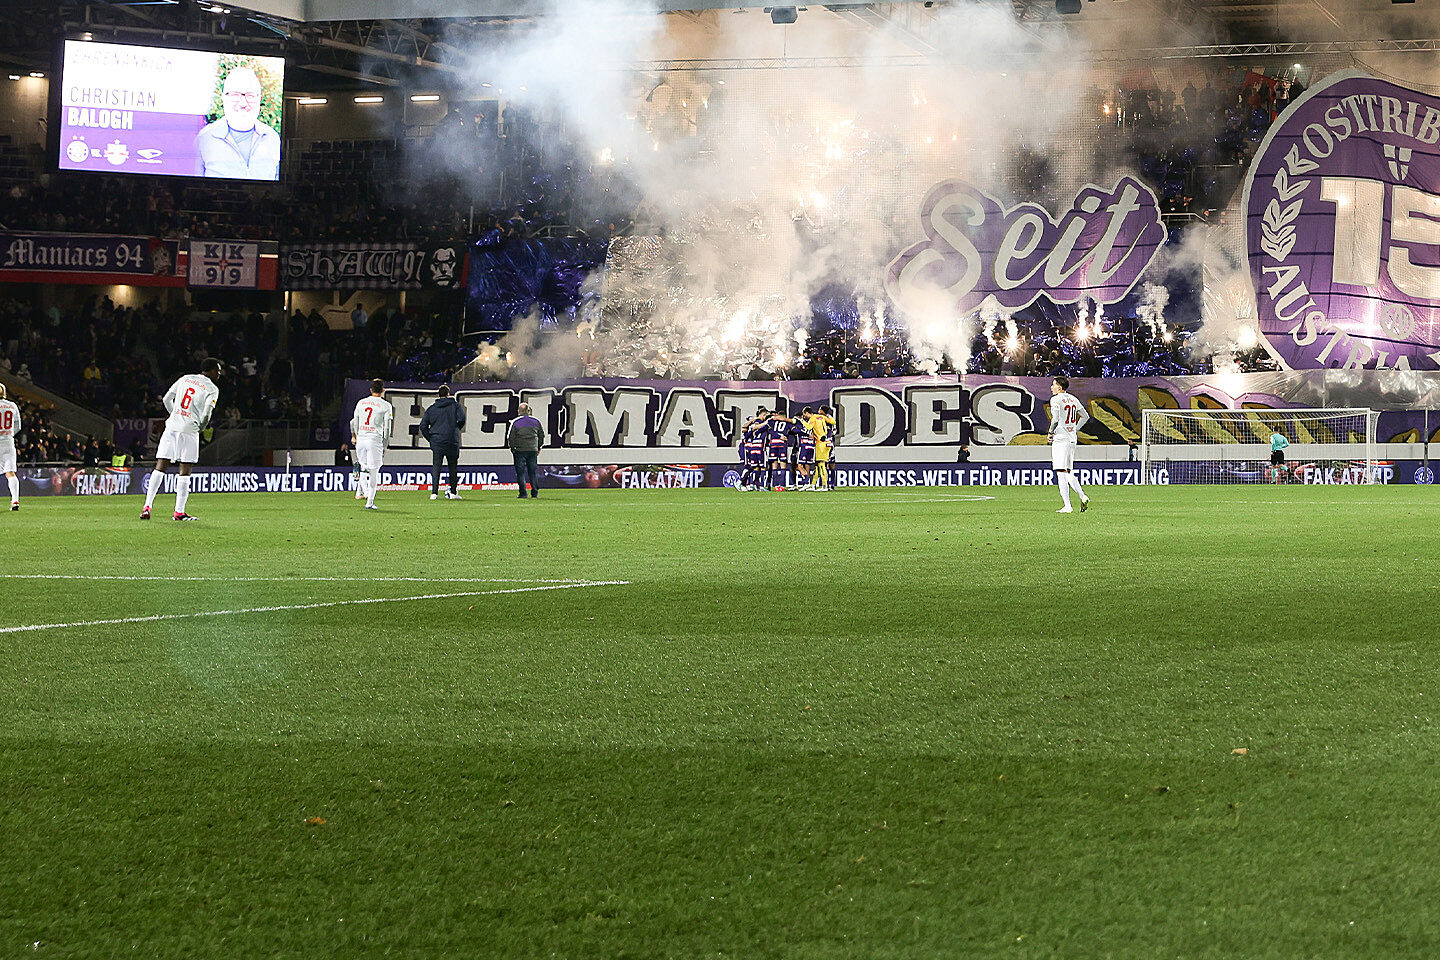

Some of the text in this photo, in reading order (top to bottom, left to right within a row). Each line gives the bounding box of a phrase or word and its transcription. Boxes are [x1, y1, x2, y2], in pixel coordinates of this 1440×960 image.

[70, 85, 157, 109] CHRISTIAN
[66, 107, 134, 130] BALOGH
[896, 181, 1150, 302] Seit
[3, 239, 144, 269] Maniacs 94
[403, 250, 426, 282] 97
[181, 387, 196, 410] 6
[364, 406, 374, 426] 7
[773, 420, 787, 432] 10
[832, 385, 1033, 447] DES
[210, 472, 310, 492] BUSINESS-WELT
[313, 468, 344, 492] FÜR
[837, 468, 966, 487] BUSINESS-WELT
[969, 465, 1001, 487] FÜR
[1006, 468, 1055, 486] MEHR
[1071, 468, 1170, 486] ERNETZUNG
